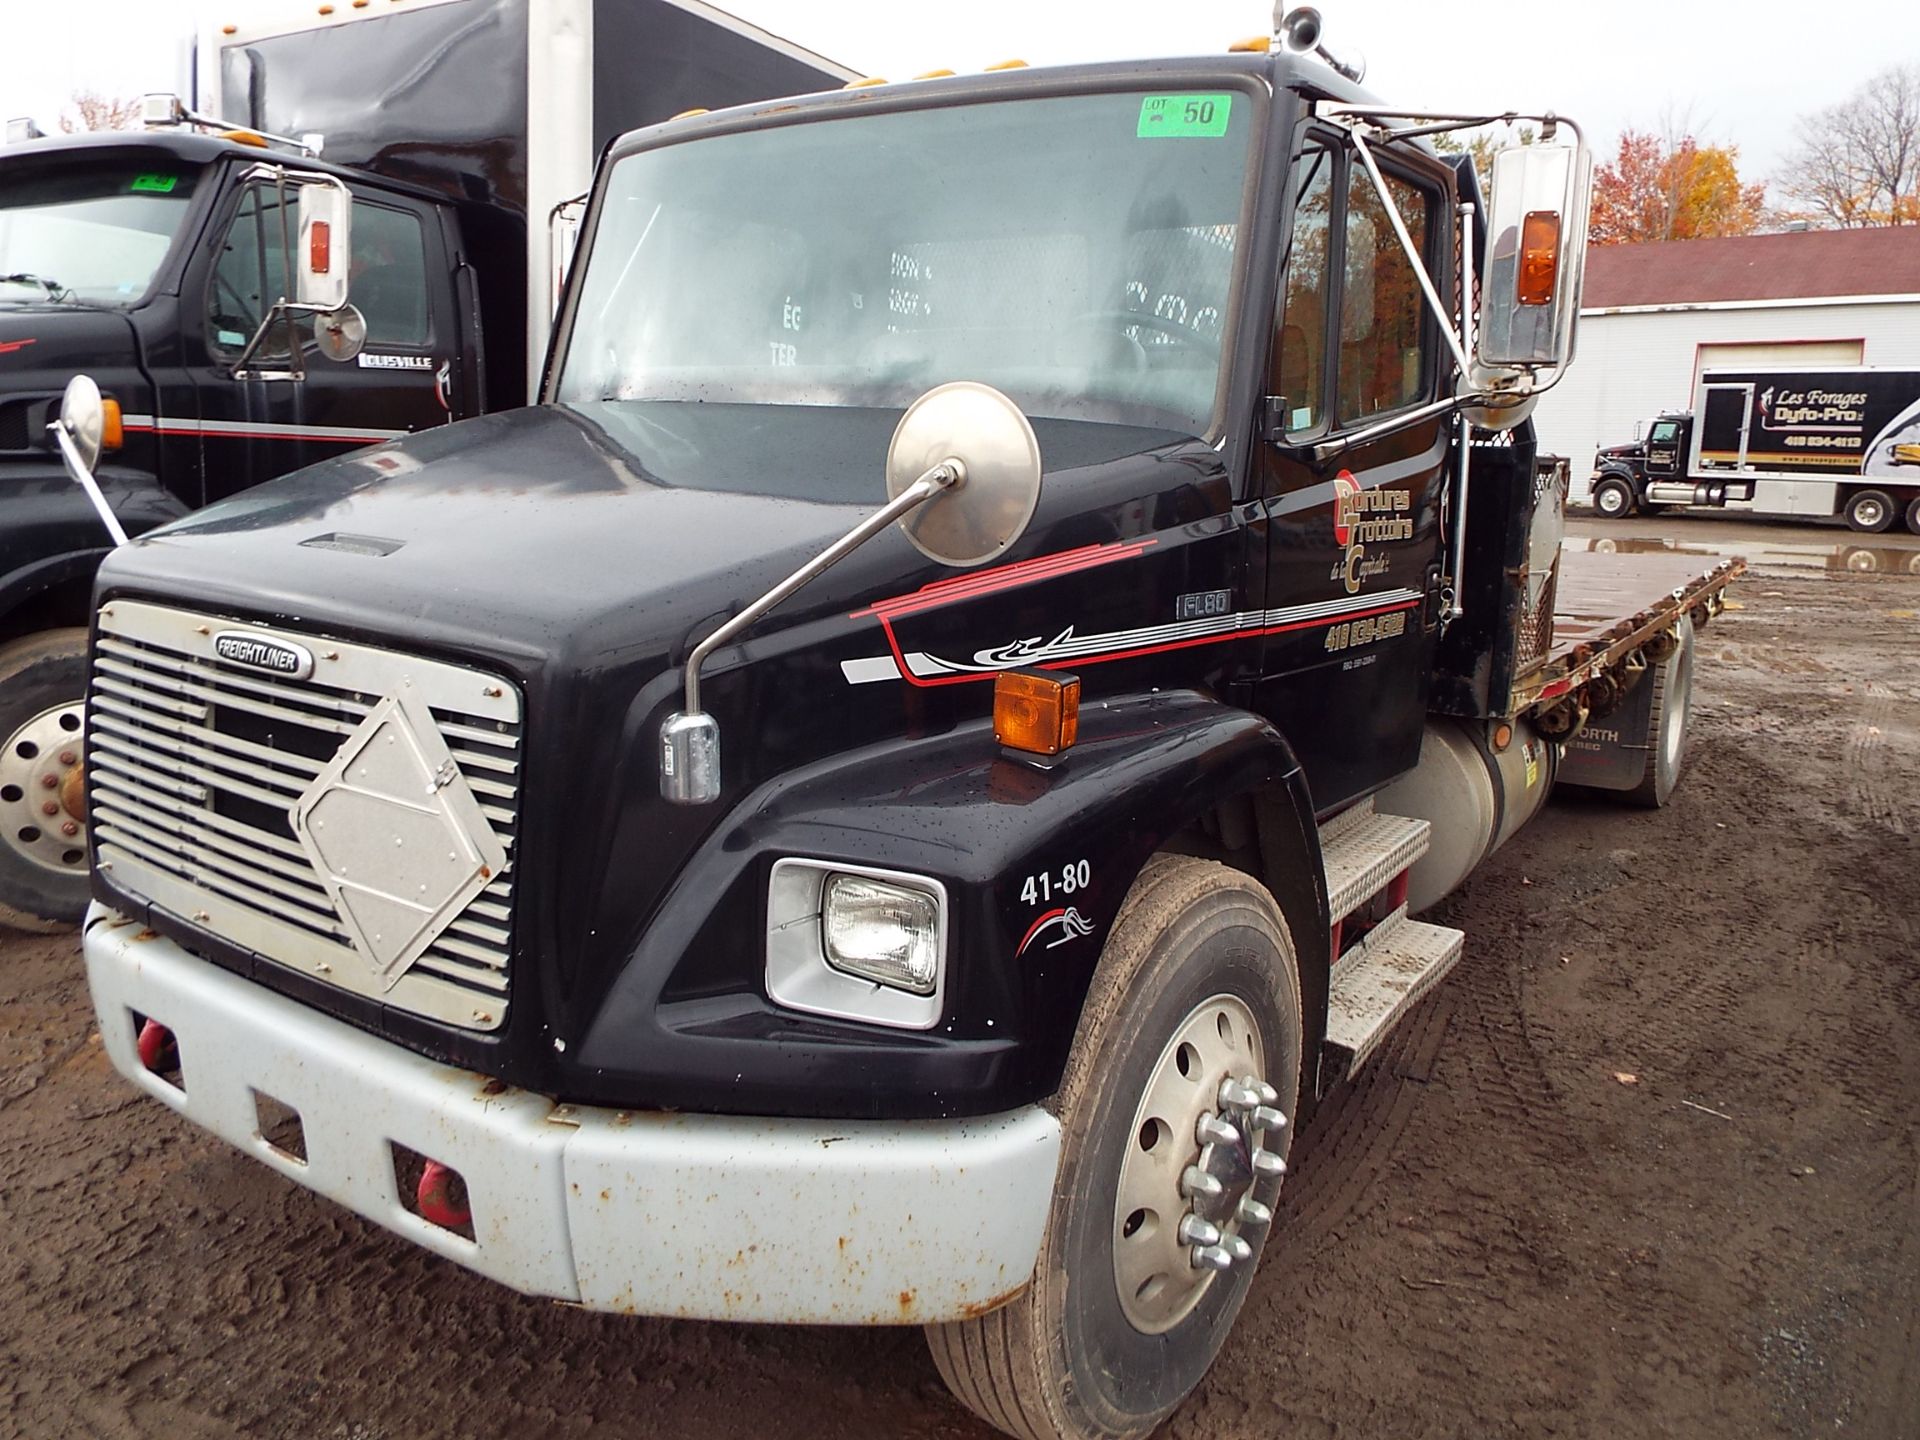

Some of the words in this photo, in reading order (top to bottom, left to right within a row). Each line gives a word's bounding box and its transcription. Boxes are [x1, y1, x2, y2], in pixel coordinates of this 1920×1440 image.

[1145, 98, 1168, 110] LOT
[1184, 101, 1215, 124] 50
[358, 353, 432, 370] LOUISVILLE
[1776, 390, 1804, 405] Les
[1807, 390, 1867, 409] Forages
[1334, 479, 1411, 526] Bordures
[1345, 513, 1413, 555] Trottoirs
[1324, 623, 1350, 652] 418
[218, 638, 297, 670] FREIGHTLINER
[1579, 727, 1618, 742] ORTH
[1020, 858, 1091, 906] 41-80
